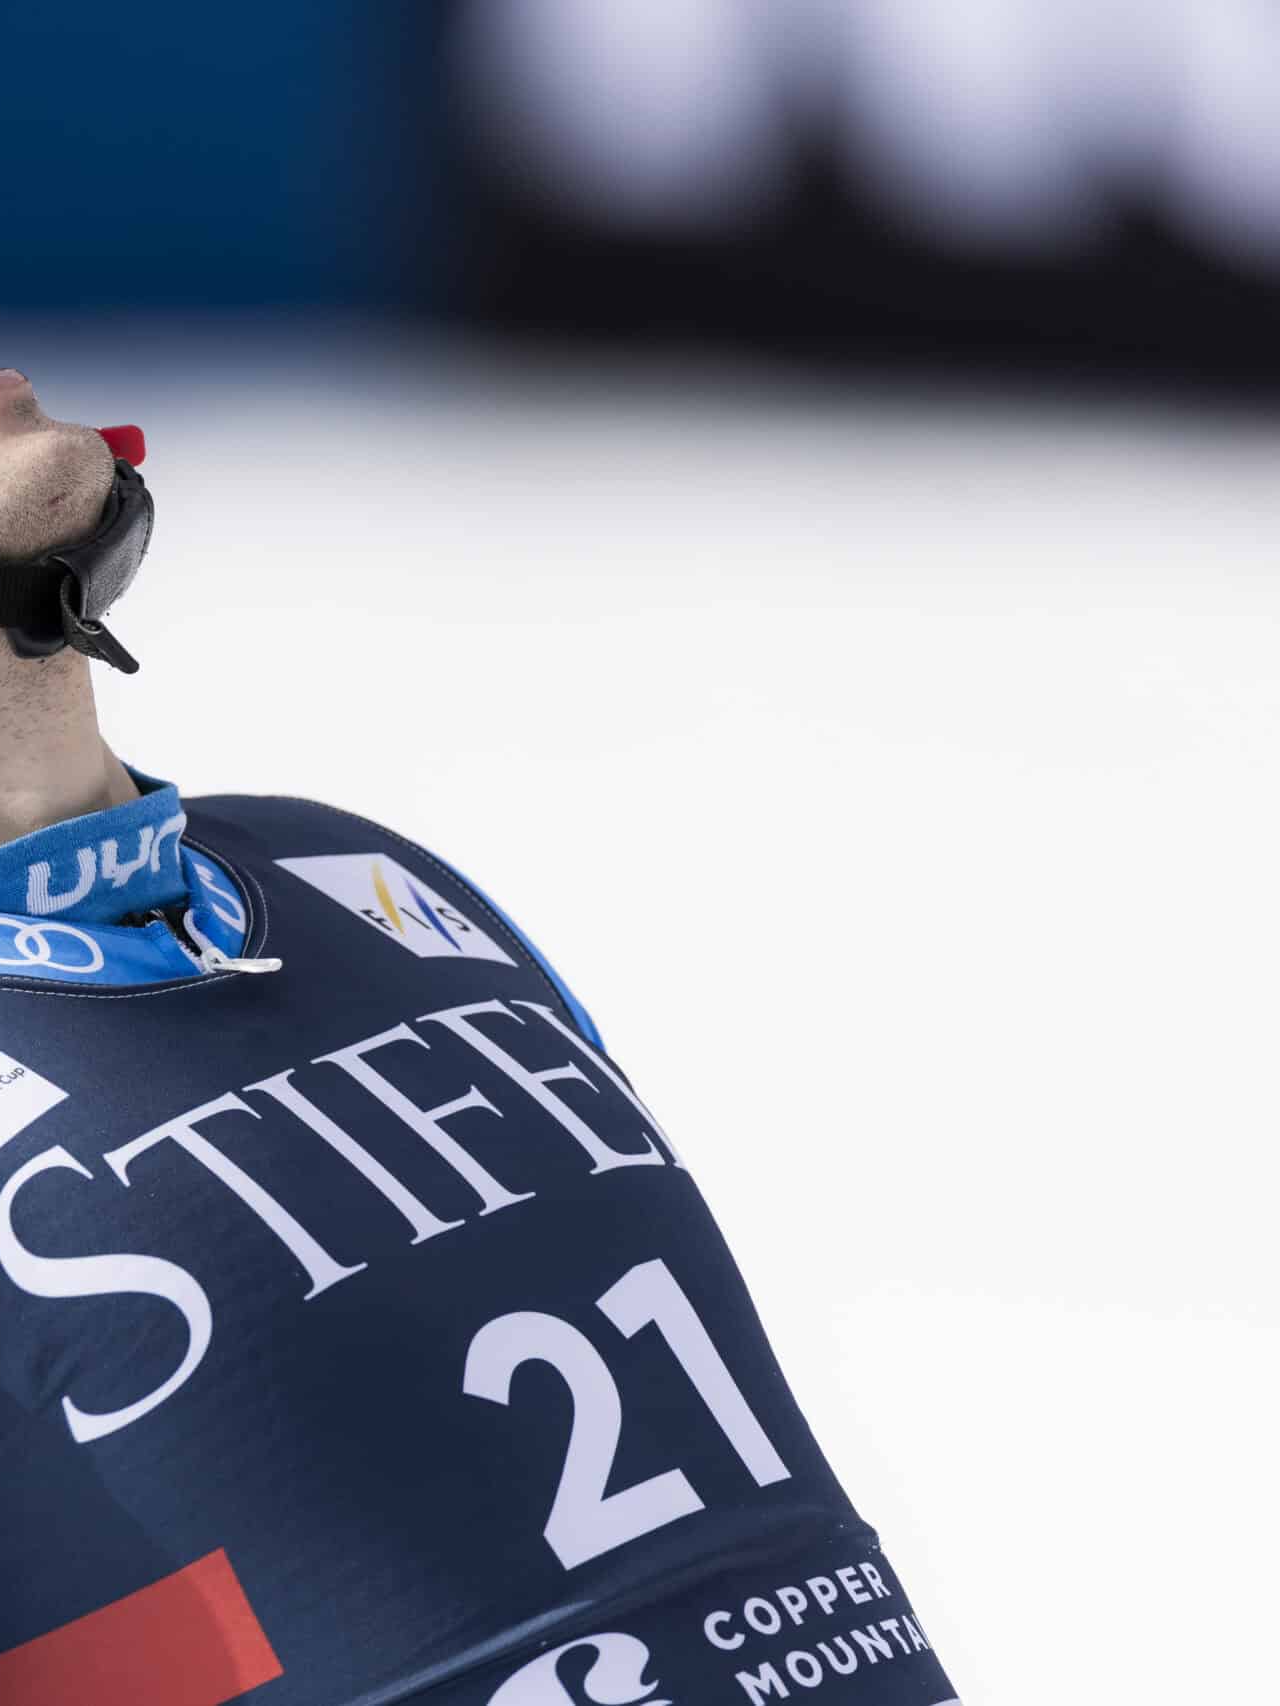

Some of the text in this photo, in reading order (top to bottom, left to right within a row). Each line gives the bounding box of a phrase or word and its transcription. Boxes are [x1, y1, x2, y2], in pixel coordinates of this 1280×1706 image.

[360, 906, 471, 932] FIS
[462, 1258, 792, 1571] 21
[703, 1562, 892, 1650] COPPER
[734, 1615, 929, 1706] MOUNTA
